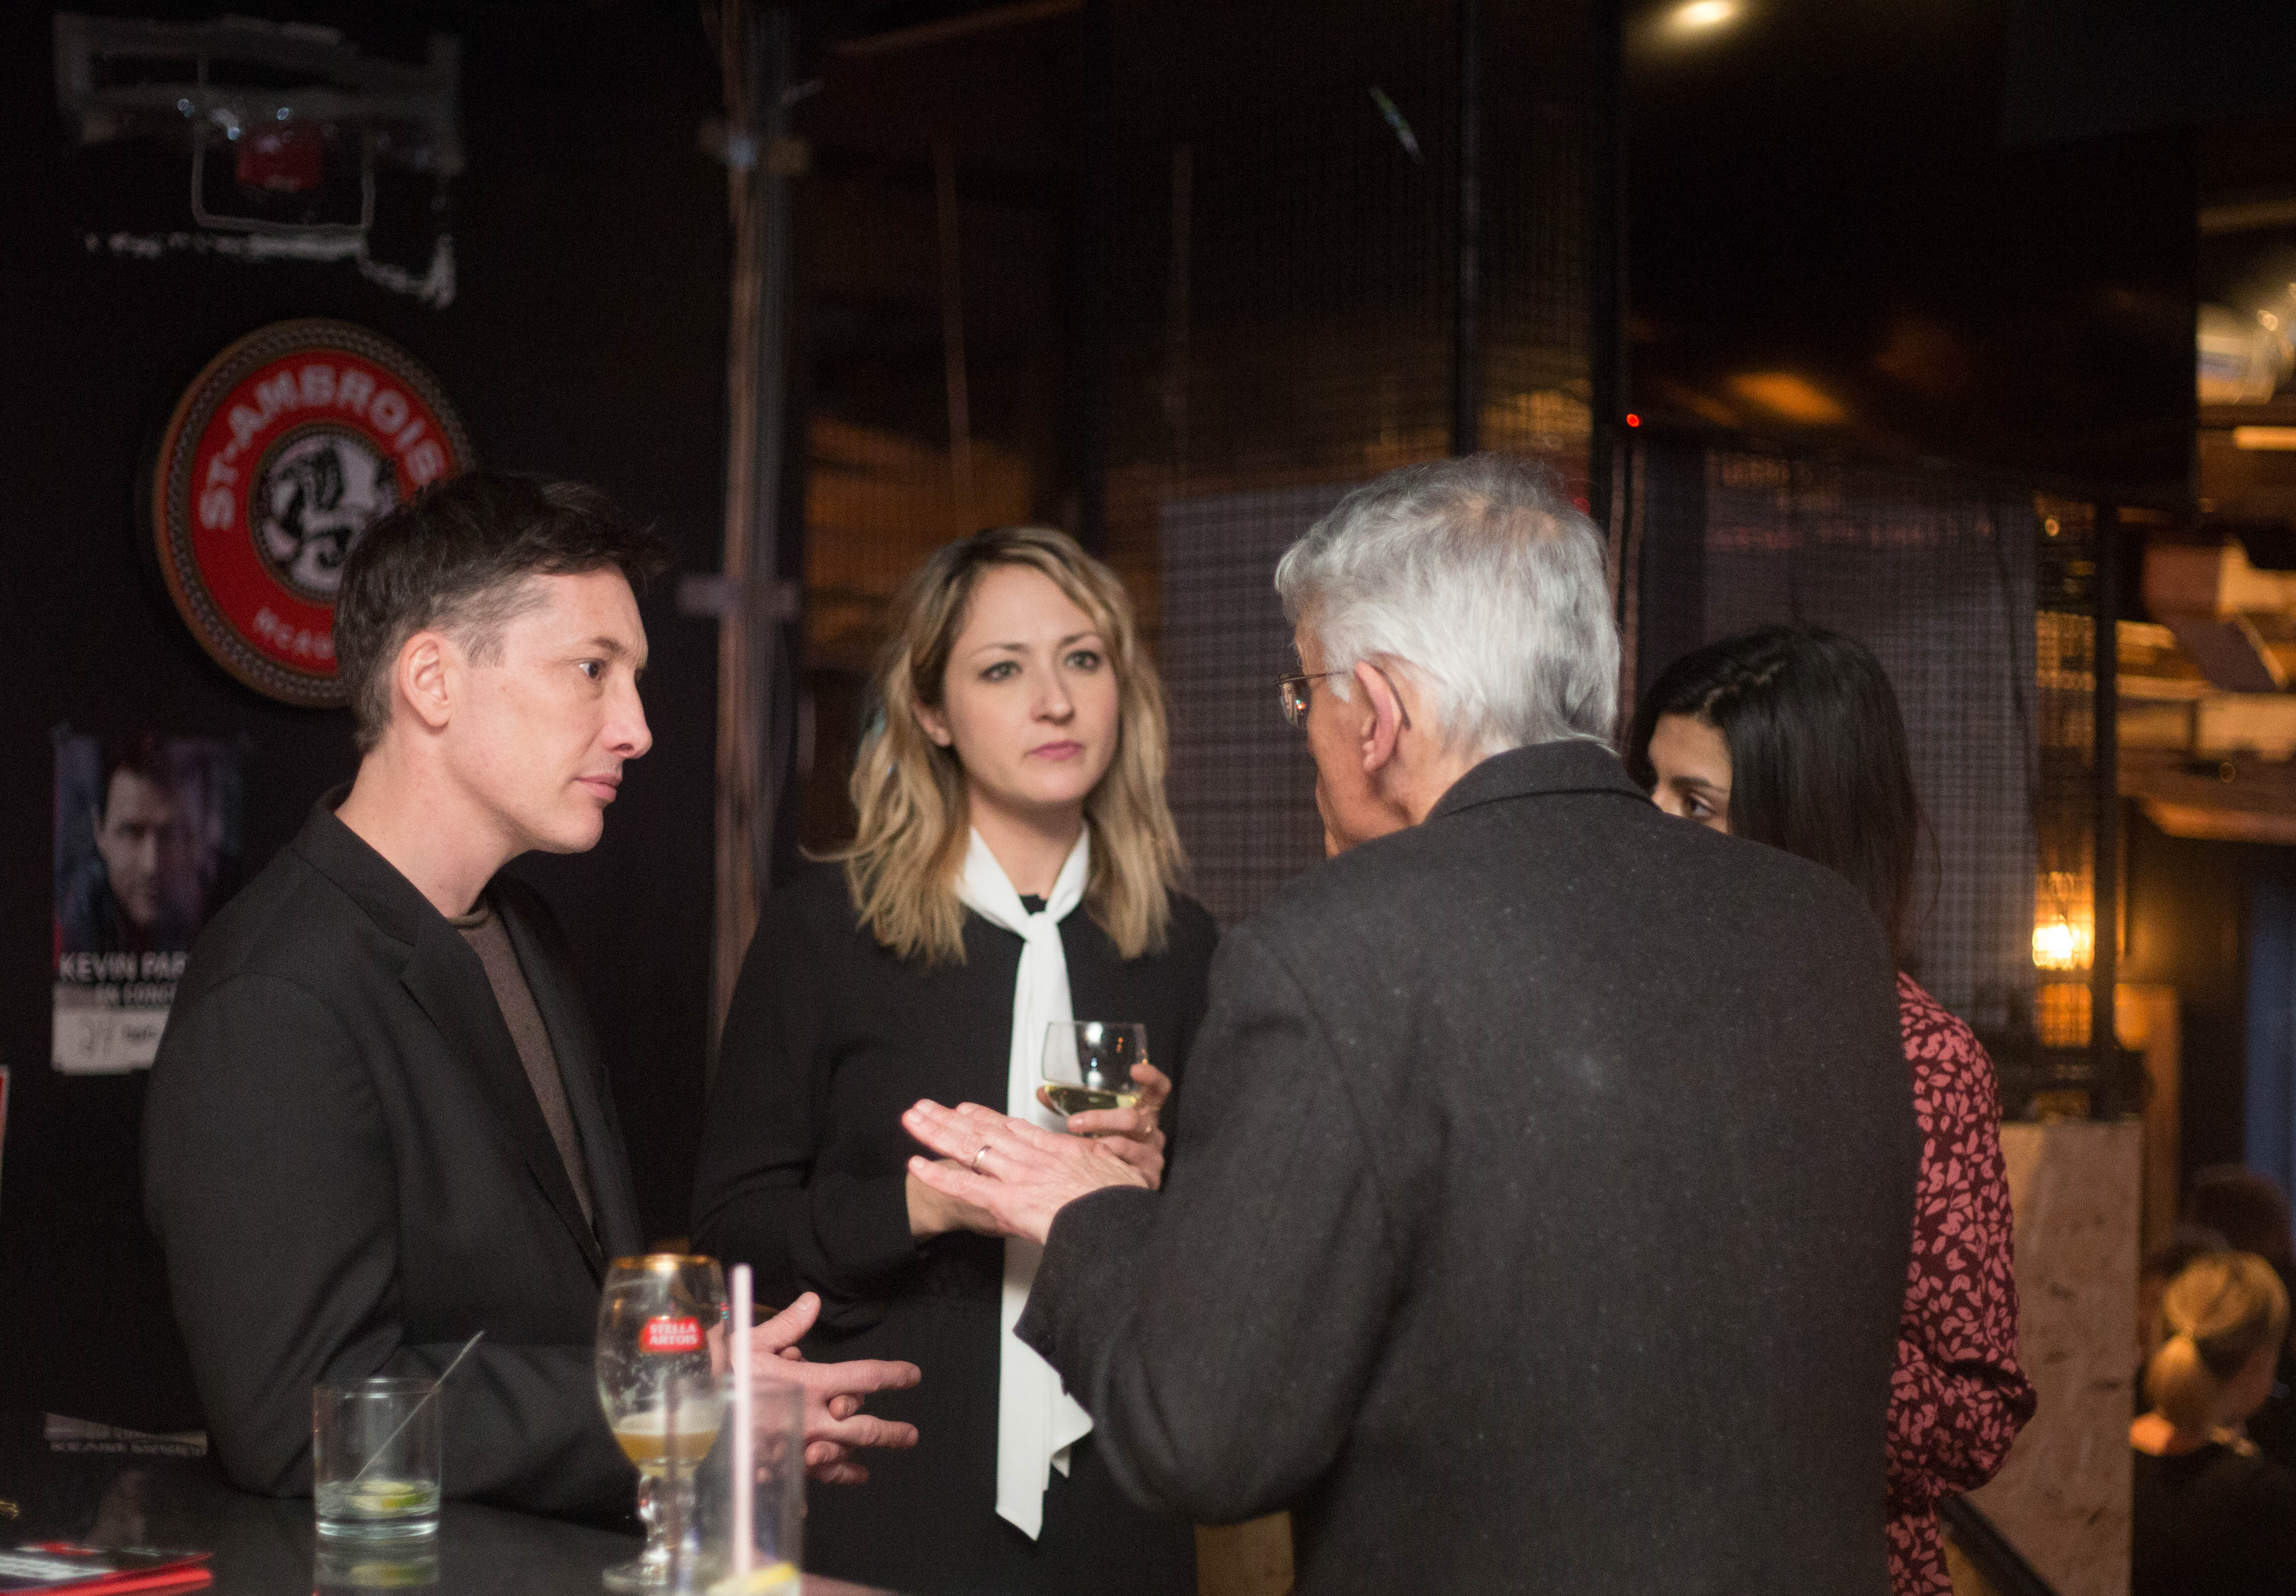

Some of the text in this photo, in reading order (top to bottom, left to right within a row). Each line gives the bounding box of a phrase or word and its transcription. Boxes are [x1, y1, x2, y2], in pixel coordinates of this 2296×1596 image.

[199, 364, 445, 530] ST-AMBROIS
[59, 951, 189, 982] KEVIN PAR
[649, 1323, 696, 1335] STELLA
[649, 1335, 698, 1345] ARTOIS
